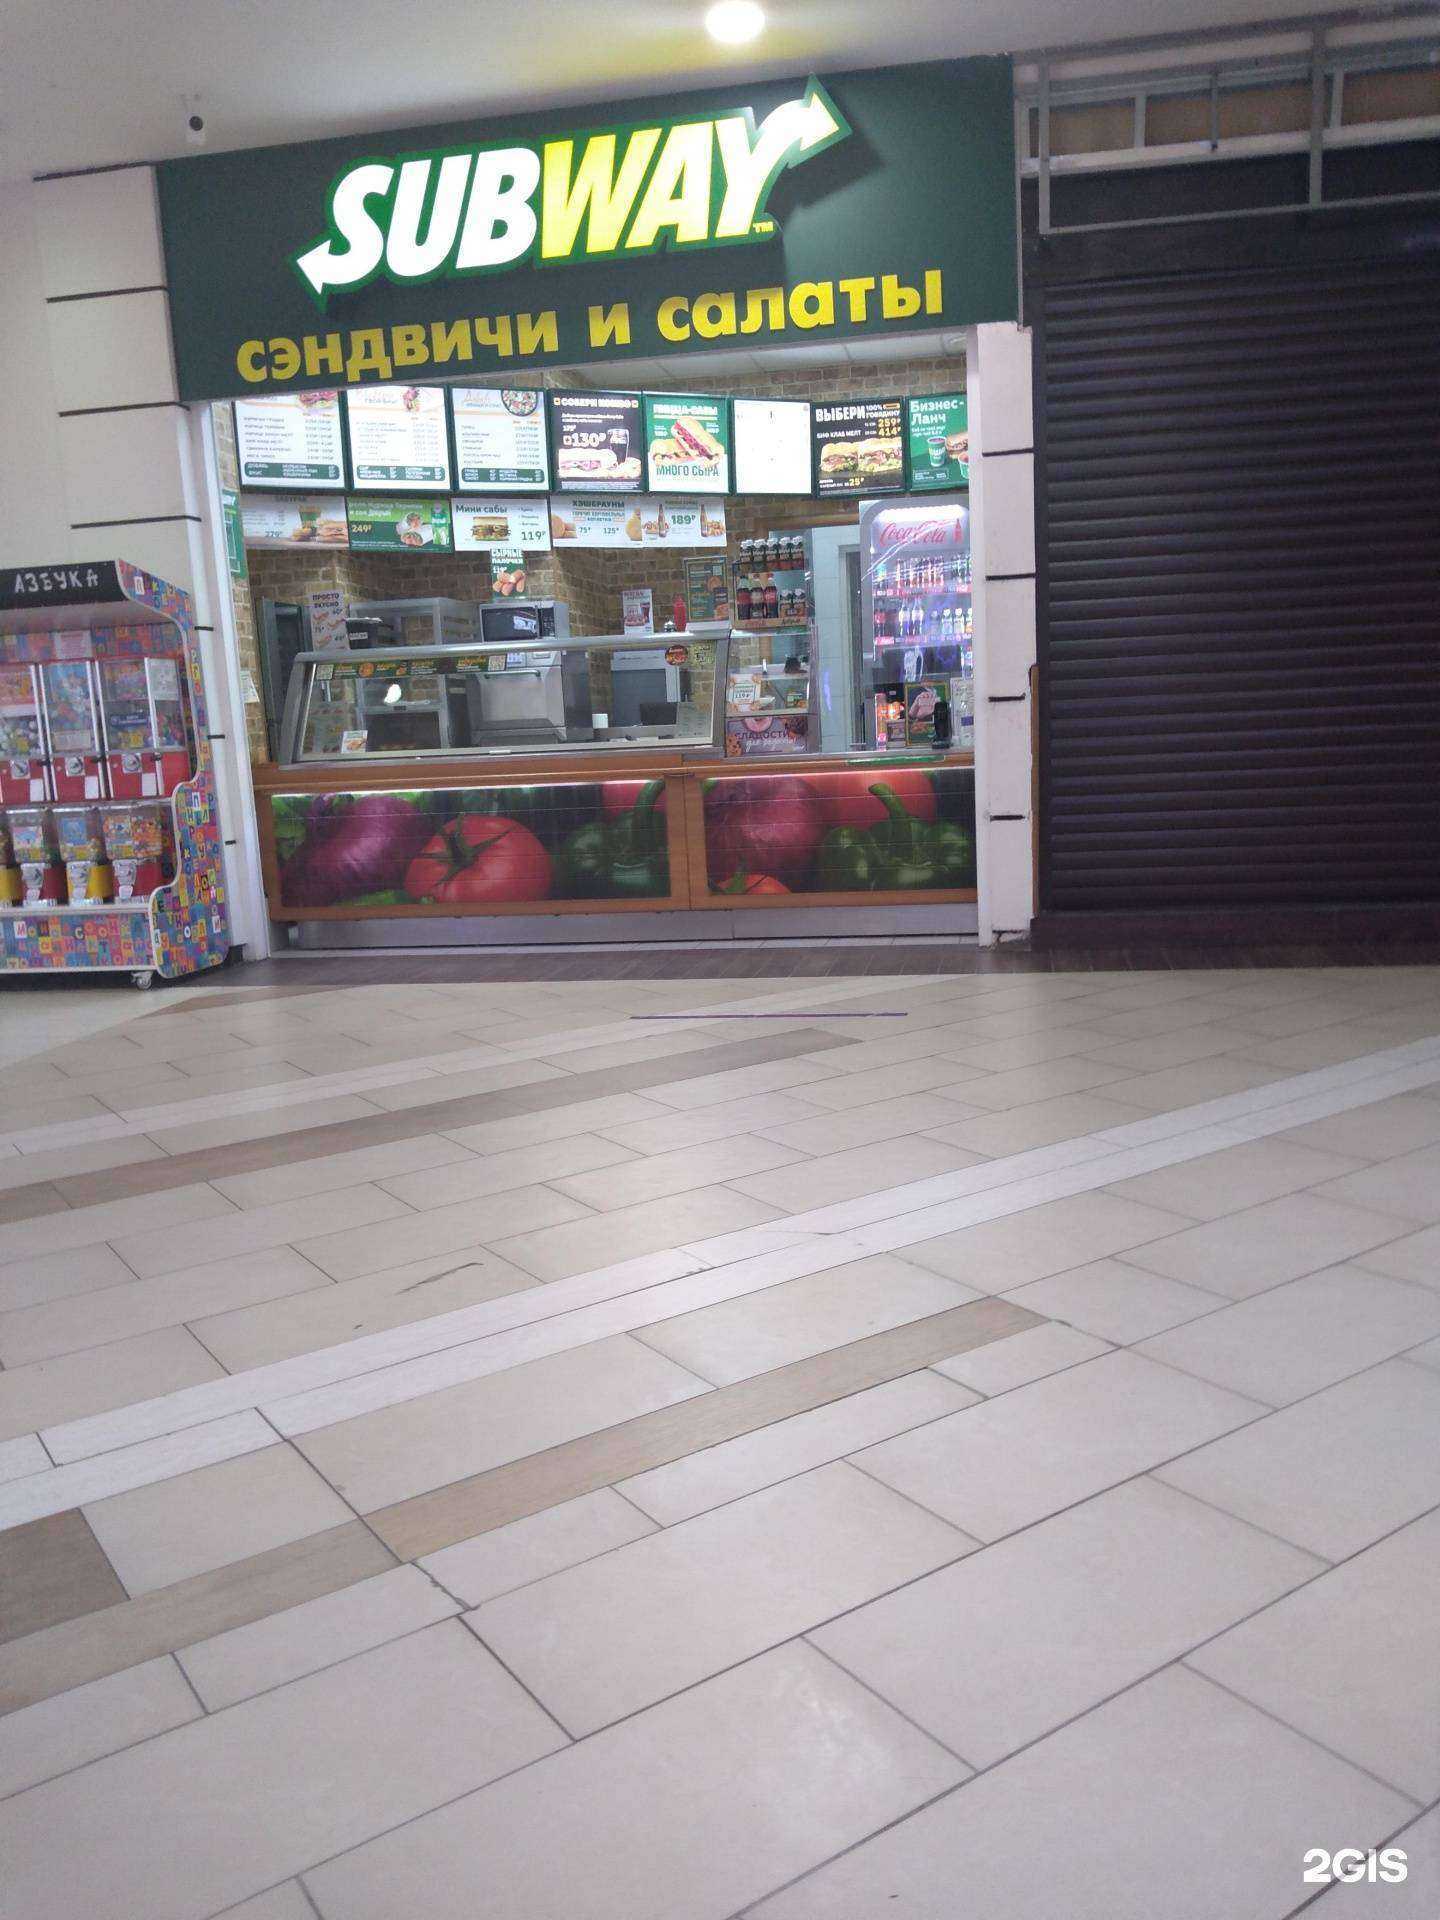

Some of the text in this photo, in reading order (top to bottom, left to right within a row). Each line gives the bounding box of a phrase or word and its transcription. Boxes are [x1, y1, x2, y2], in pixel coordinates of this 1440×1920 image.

[298, 93, 840, 295] SUBWAY
[236, 269, 944, 385] сэндвичи и салаты
[910, 399, 965, 412] Бизнес-
[815, 405, 866, 422] ВЫБЕРИ
[911, 413, 946, 426] Ланч
[656, 465, 720, 477] МНОГО СЫРА
[456, 504, 508, 513] Мини сабы
[879, 519, 947, 547] Coca-Cola
[14, 568, 98, 593] АЗБУКА
[735, 730, 791, 740] СЛАДОСТИ
